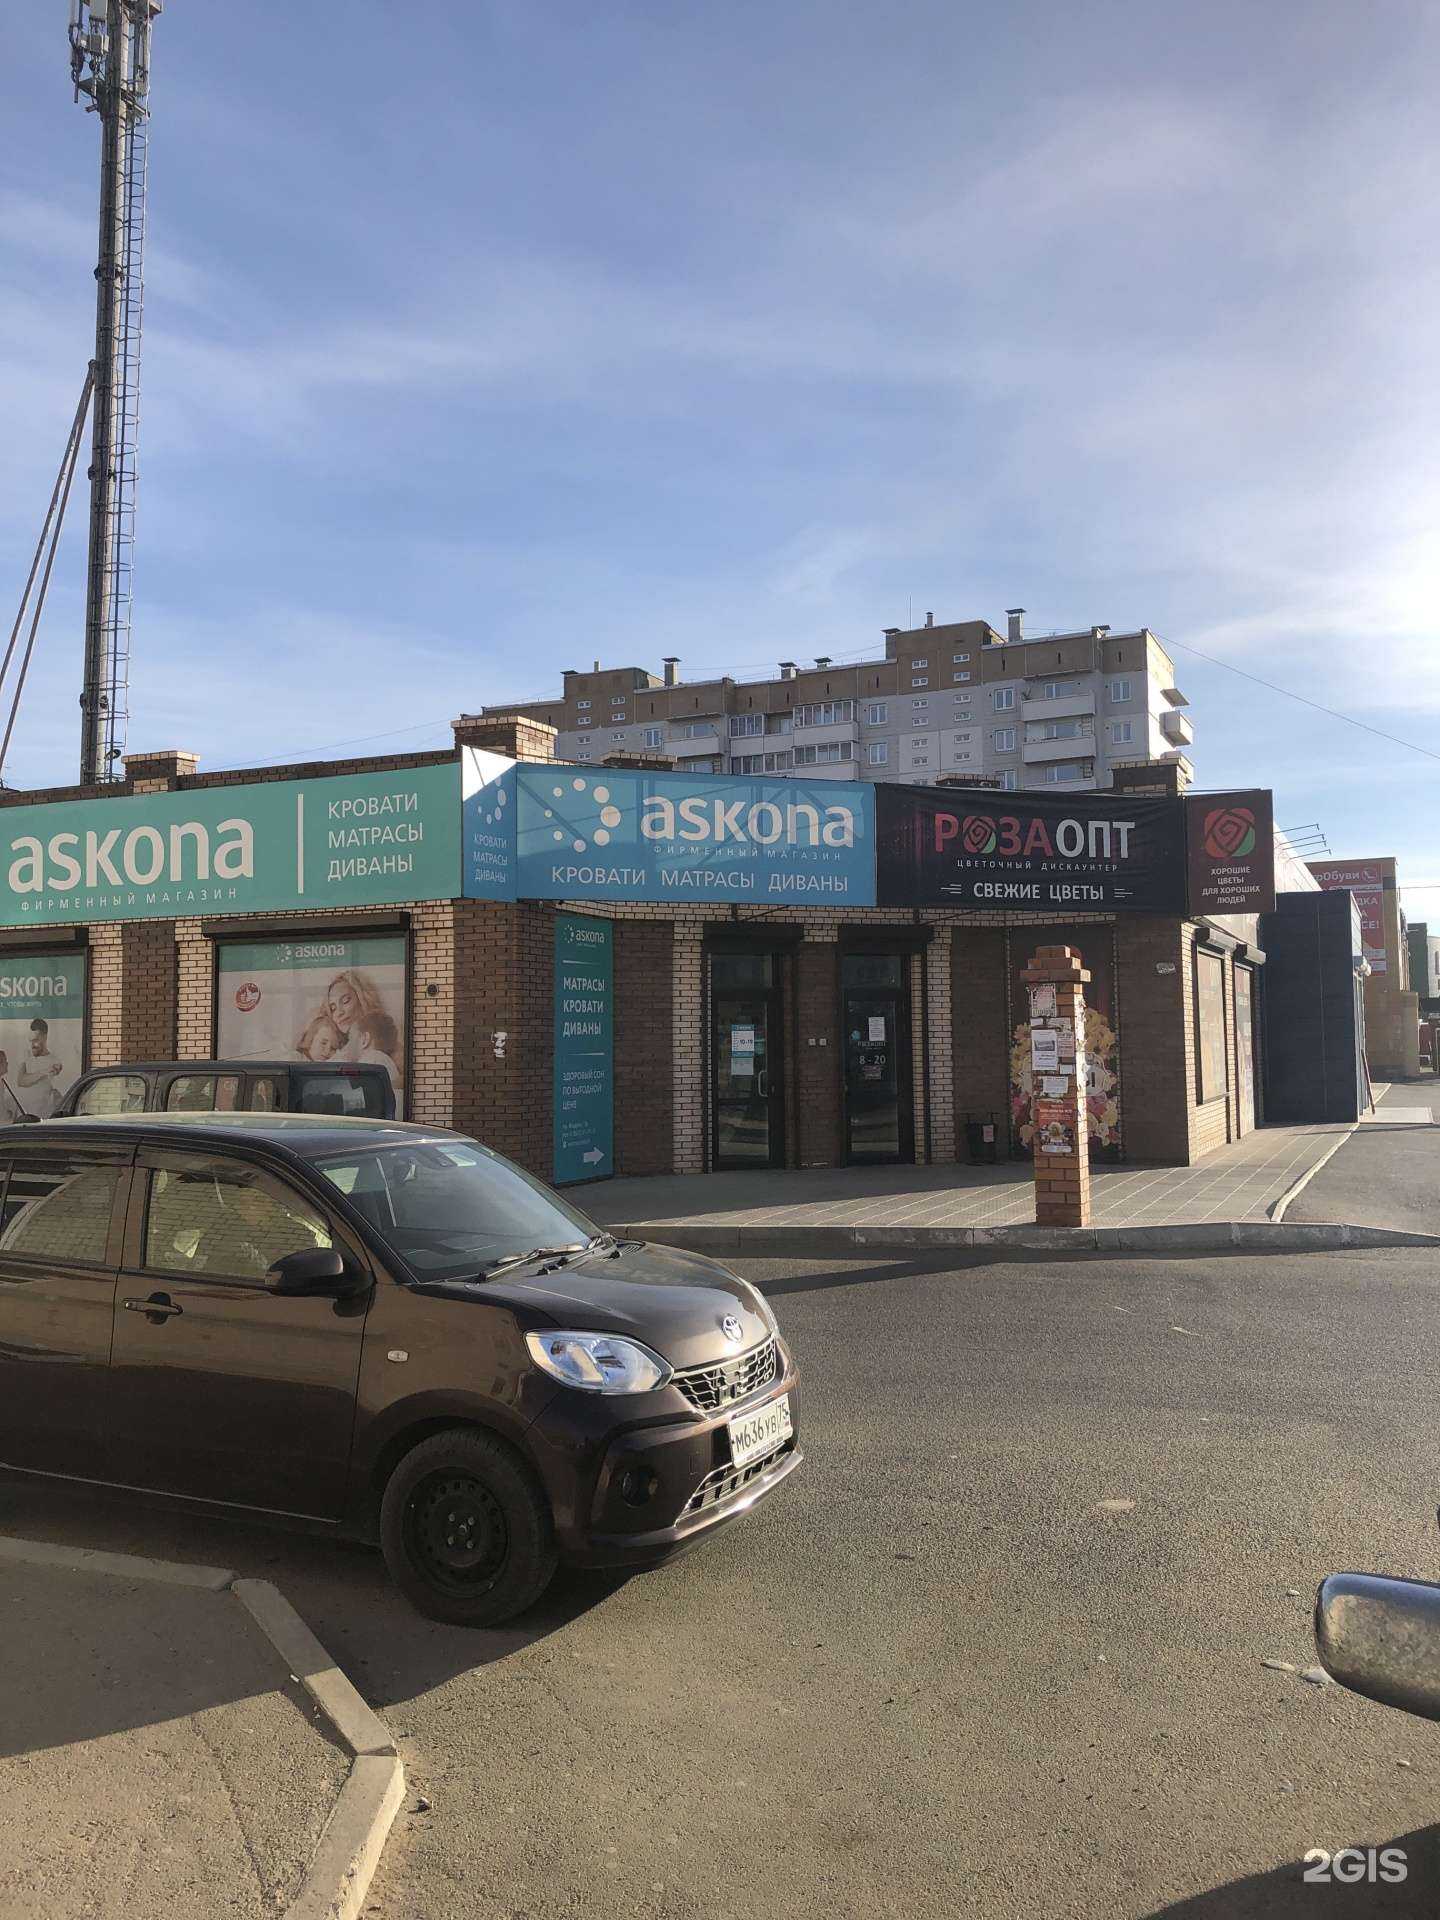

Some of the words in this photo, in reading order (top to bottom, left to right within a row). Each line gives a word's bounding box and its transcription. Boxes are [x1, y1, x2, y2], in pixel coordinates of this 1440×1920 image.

[327, 793, 418, 819] КРОВАТИ
[640, 796, 854, 848] askona
[327, 823, 424, 849] МАТРАСЫ
[473, 833, 507, 849] КРОВАТИ
[8, 818, 254, 893] askona
[473, 851, 508, 866] МАТРАСЫ
[653, 846, 758, 857] ФИРМЕННЫЙ
[767, 850, 841, 861] МАГАЗИН
[327, 854, 413, 882] ДИВАНЫ
[957, 859, 1032, 869] ЦВЕТОЧНЫЙ
[1041, 862, 1118, 872] ДИСКАУНТЕР
[1211, 866, 1252, 876] ХОРОШИЕ
[474, 869, 507, 883] ДИВАНЫ
[552, 866, 645, 886] КРОВАТИ
[661, 870, 754, 888] МАТРАСЫ
[768, 874, 848, 892] ДИВАНЫ
[1217, 876, 1245, 885] ЦВЕТЫ
[973, 882, 1041, 899] СВЕЖИЕ
[1049, 885, 1104, 902] ЦВЕТЫ
[1202, 887, 1219, 896] ДЛЯ
[1220, 885, 1261, 894] ХОРОШИХ
[21, 893, 136, 911] ФИРМЕННЫЙ
[146, 887, 237, 904] МАГАЗИН
[1217, 895, 1246, 904] ЛЮДЕЙ
[575, 929, 605, 943] askona
[295, 943, 345, 958] askona
[563, 977, 605, 991] МАТРАСЫ
[563, 1000, 604, 1013] КРОВАТИ
[563, 1021, 602, 1037] ДИВАНЫ
[874, 1055, 886, 1065] 20
